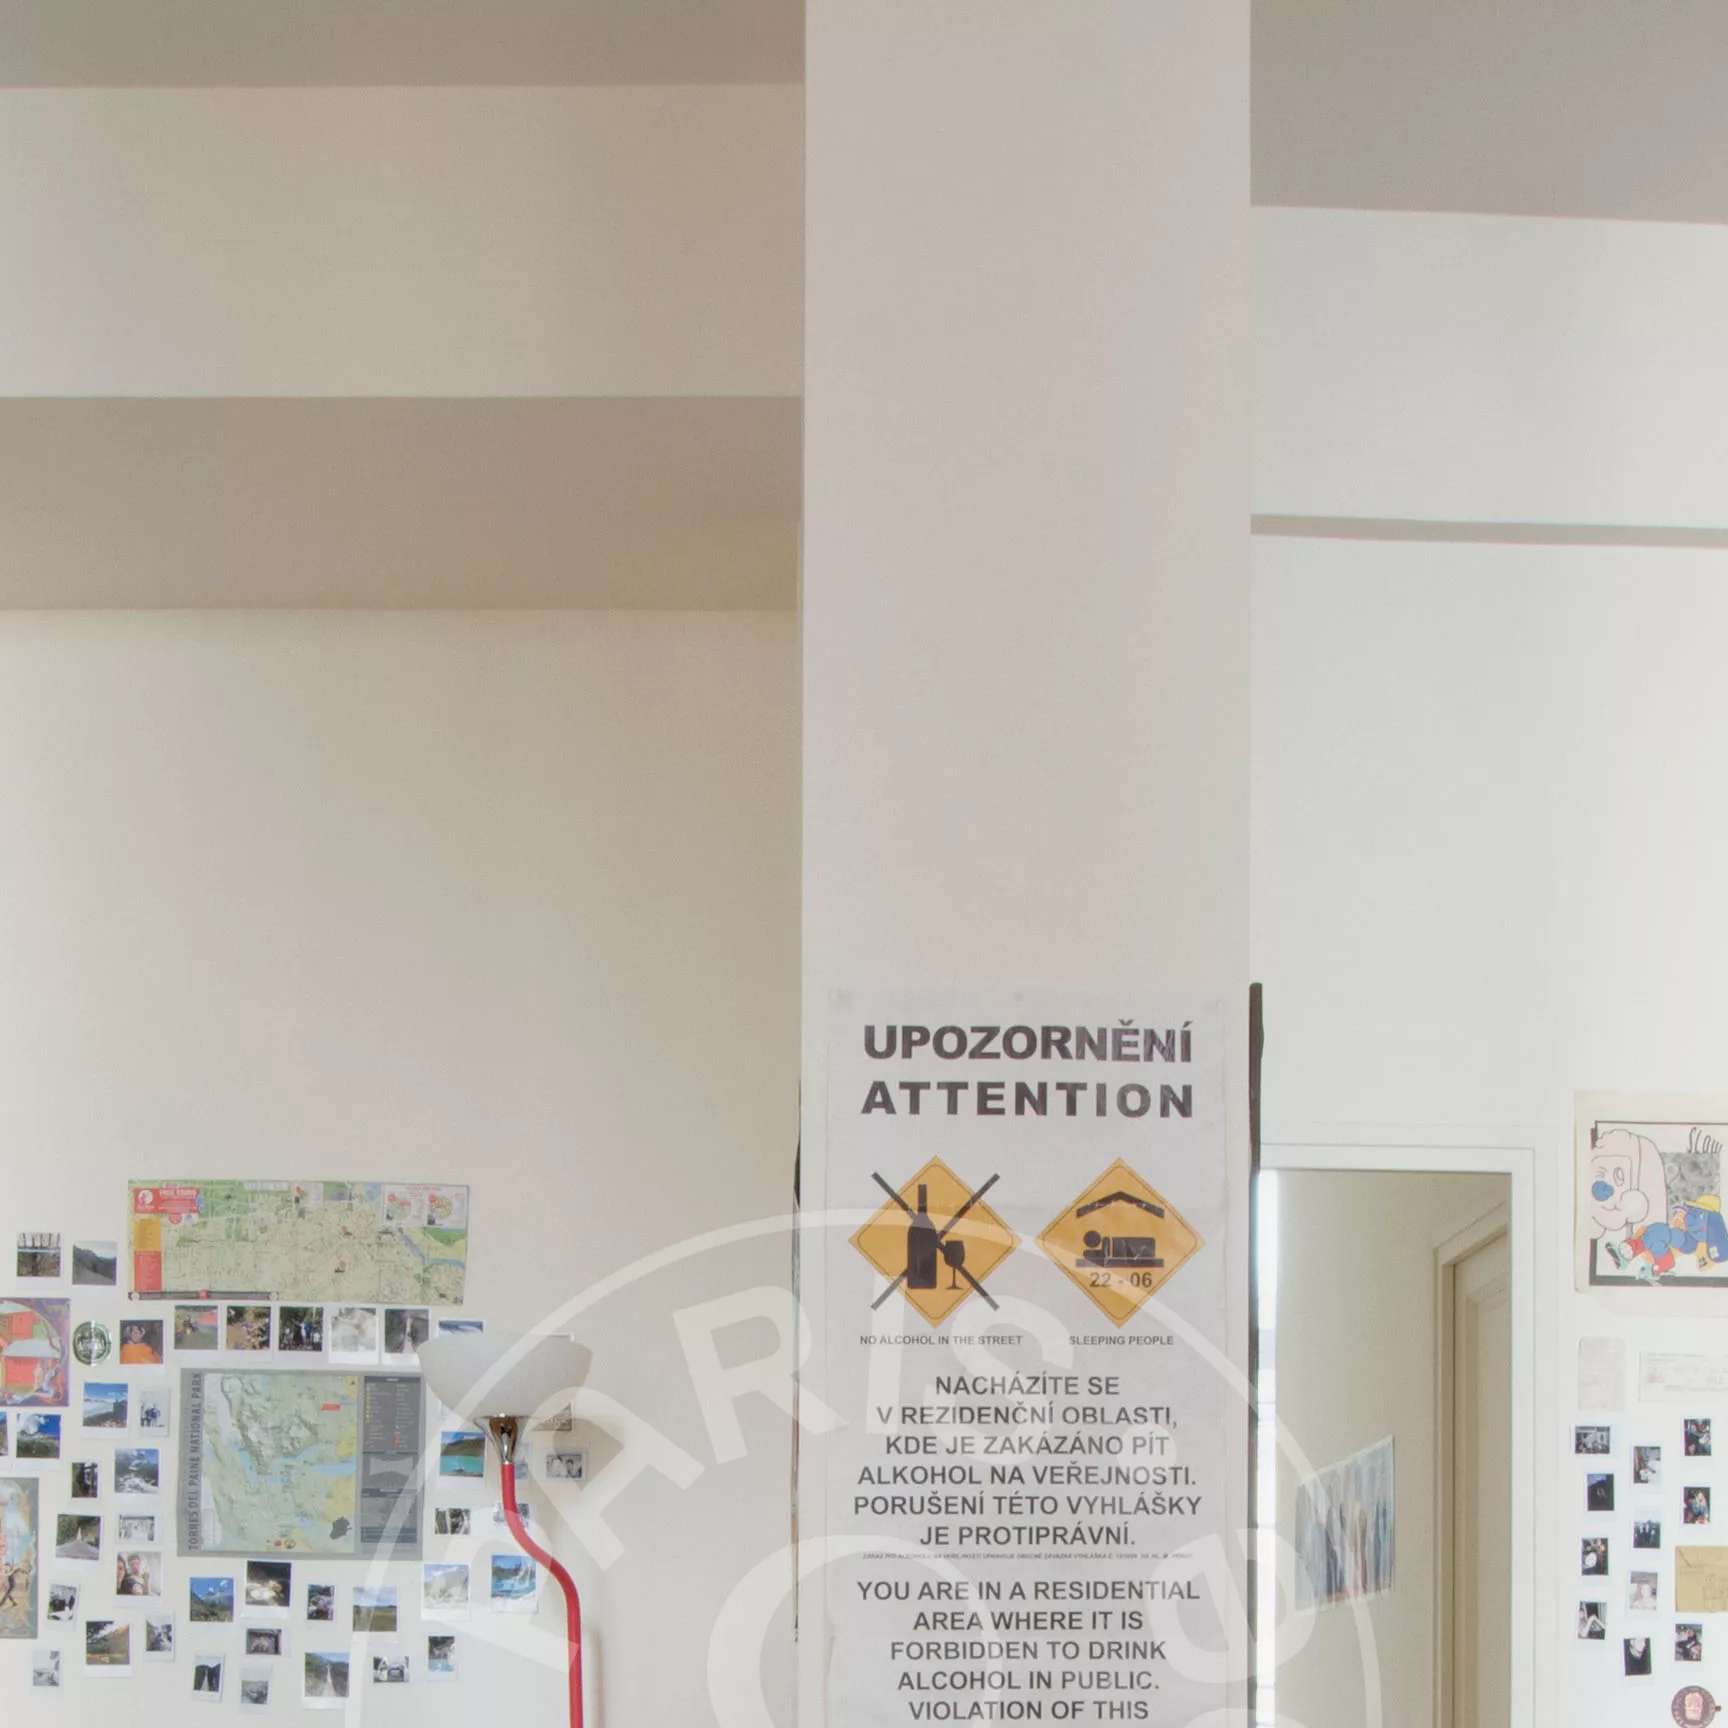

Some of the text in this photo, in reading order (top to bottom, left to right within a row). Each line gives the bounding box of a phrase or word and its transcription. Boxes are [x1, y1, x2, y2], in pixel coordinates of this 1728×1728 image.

[863, 1019, 1193, 1063] UPOZORNĚNÍ
[861, 1080, 1193, 1118] ATTENTION
[1089, 1272, 1110, 1289] 22
[1130, 1272, 1153, 1289] 06
[860, 1336, 1023, 1346] NO ALCOHOL IN THE STREET
[1069, 1336, 1174, 1346] SLEEPING PEOPLE
[936, 1371, 1120, 1396] NACHÁZÍTE SE
[189, 1402, 201, 1453] NATIONAL
[877, 1401, 1177, 1429] V REZIDENČNÍ OBLASTI,
[886, 1430, 1170, 1455] KDE JE ZAKÁZÁNO PÍT
[857, 1460, 1196, 1486] ALKOHOL NA VEŘEJNOSTI.
[854, 1490, 1202, 1516] PORUŠENÍ TÉTO VYHLÁŠKY
[920, 1521, 1135, 1546] JE PROTIPRÁVNÍ.
[857, 1581, 1201, 1601] YOU ARE IN A RESIDENTIAL
[912, 1611, 1144, 1631] AREA WHERE IT IS
[890, 1641, 1167, 1661] FORBIDDEN TO DRINK
[897, 1671, 1160, 1691] ALCOHOL IN PUBLIC.
[908, 1701, 1149, 1721] VIOLATION OF THIS
